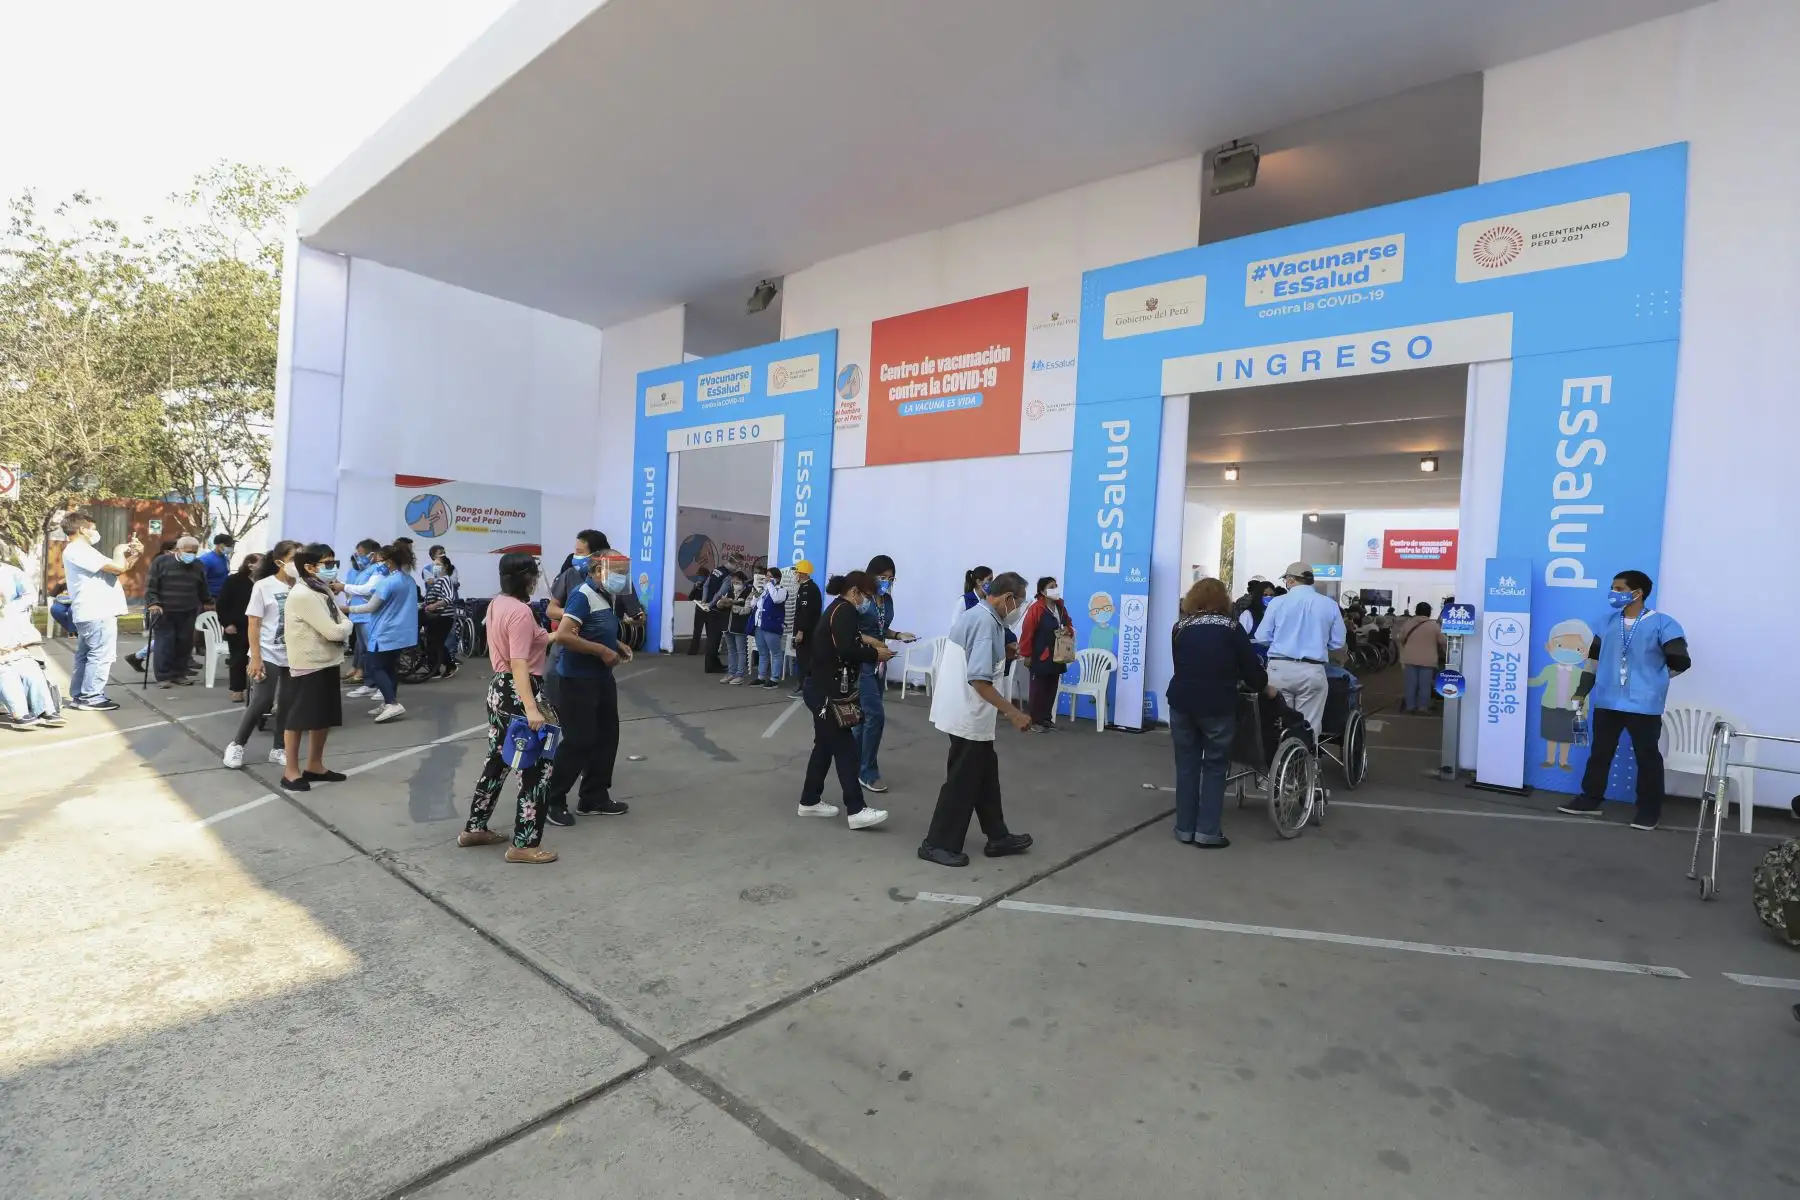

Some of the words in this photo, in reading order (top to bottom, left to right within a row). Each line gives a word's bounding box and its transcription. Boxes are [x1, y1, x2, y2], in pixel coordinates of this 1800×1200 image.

[1531, 220, 1610, 240] BICENTENARIO
[1562, 233, 1584, 243] 2021
[1251, 243, 1398, 282] #Vacunarse
[1273, 264, 1370, 298] EsSalud
[1258, 303, 1301, 319] contra
[1303, 300, 1315, 312] la
[1317, 289, 1385, 310] COVID-19
[1115, 314, 1152, 326] Gobierno
[1154, 310, 1167, 320] del
[1169, 306, 1189, 317] Perú
[880, 361, 920, 383] Centro
[920, 356, 936, 376] de
[937, 344, 1011, 373] vacunación
[1046, 357, 1076, 370] EsSalud
[1216, 335, 1433, 383] INGRESO
[700, 371, 749, 386] #Vacunarse
[707, 381, 740, 398] EsSalud
[888, 380, 929, 401] contra
[929, 376, 941, 396] la
[942, 366, 998, 394] COVID-19
[904, 404, 913, 414] LA
[914, 400, 945, 412] VACUNA
[946, 398, 955, 408] ES
[957, 396, 977, 407] VIDA
[686, 424, 760, 446] INGRESO
[1545, 375, 1612, 589] EsSalud
[1094, 419, 1130, 574] EsSalud
[455, 515, 471, 524] por
[482, 516, 502, 525] Perú
[456, 505, 483, 516] Pongo
[494, 508, 526, 518] hombro
[640, 466, 656, 562] EsSalud
[721, 542, 745, 553] Pongo
[1490, 587, 1526, 596] EsSalud
[1133, 625, 1142, 655] Zona
[1122, 624, 1133, 680] Admisión
[1131, 661, 1140, 673] de
[1505, 652, 1521, 691] Zona
[1488, 651, 1505, 724] Admisión
[1504, 695, 1520, 715] de
